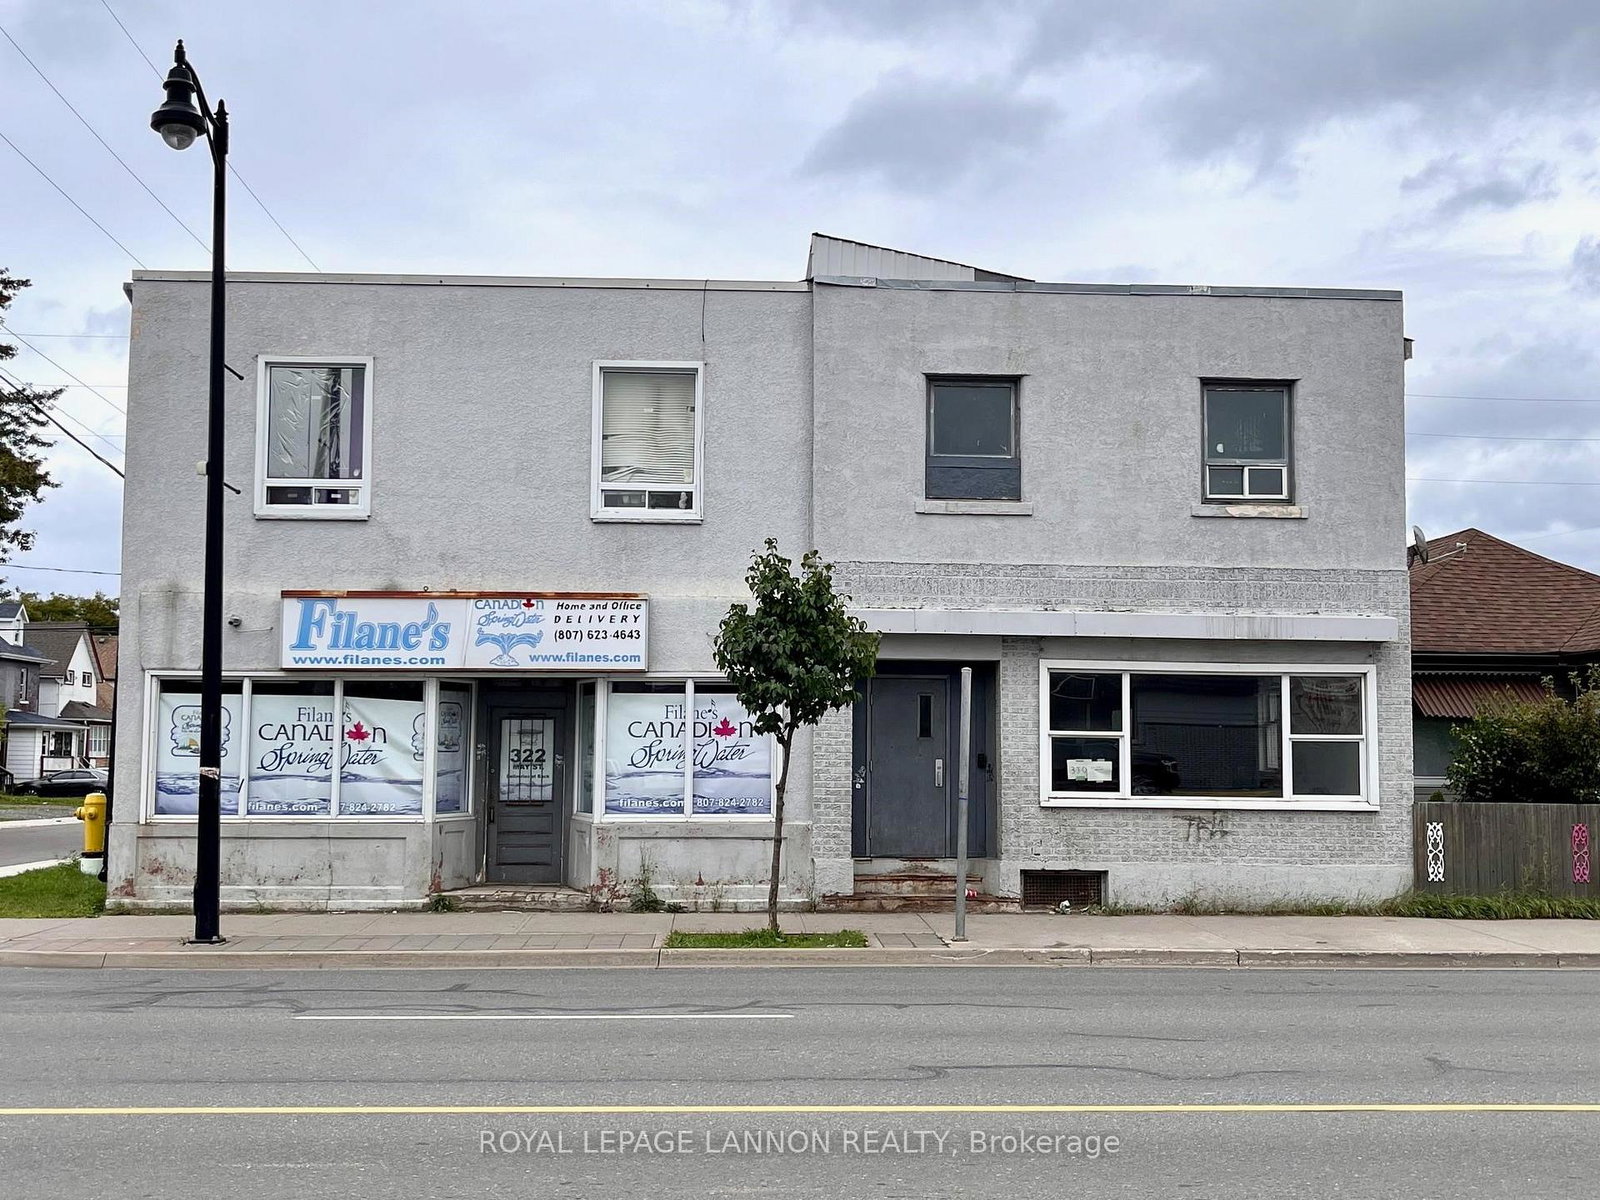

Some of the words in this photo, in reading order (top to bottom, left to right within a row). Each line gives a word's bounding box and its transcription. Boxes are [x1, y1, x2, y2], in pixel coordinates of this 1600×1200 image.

[556, 601, 586, 611] Home
[589, 602, 607, 611] and
[611, 601, 642, 610] Office
[289, 598, 451, 651] Filane's
[554, 630, 583, 642] (807)
[587, 629, 641, 640] 623-4643
[293, 654, 445, 665] www.filanes.com
[529, 652, 641, 663] www.filanes.com
[297, 706, 352, 722] Filan's
[665, 704, 718, 719] Filne's
[510, 749, 546, 763] 322
[327, 803, 396, 813] 7-824-2782
[696, 798, 764, 808] 807-824-2782
